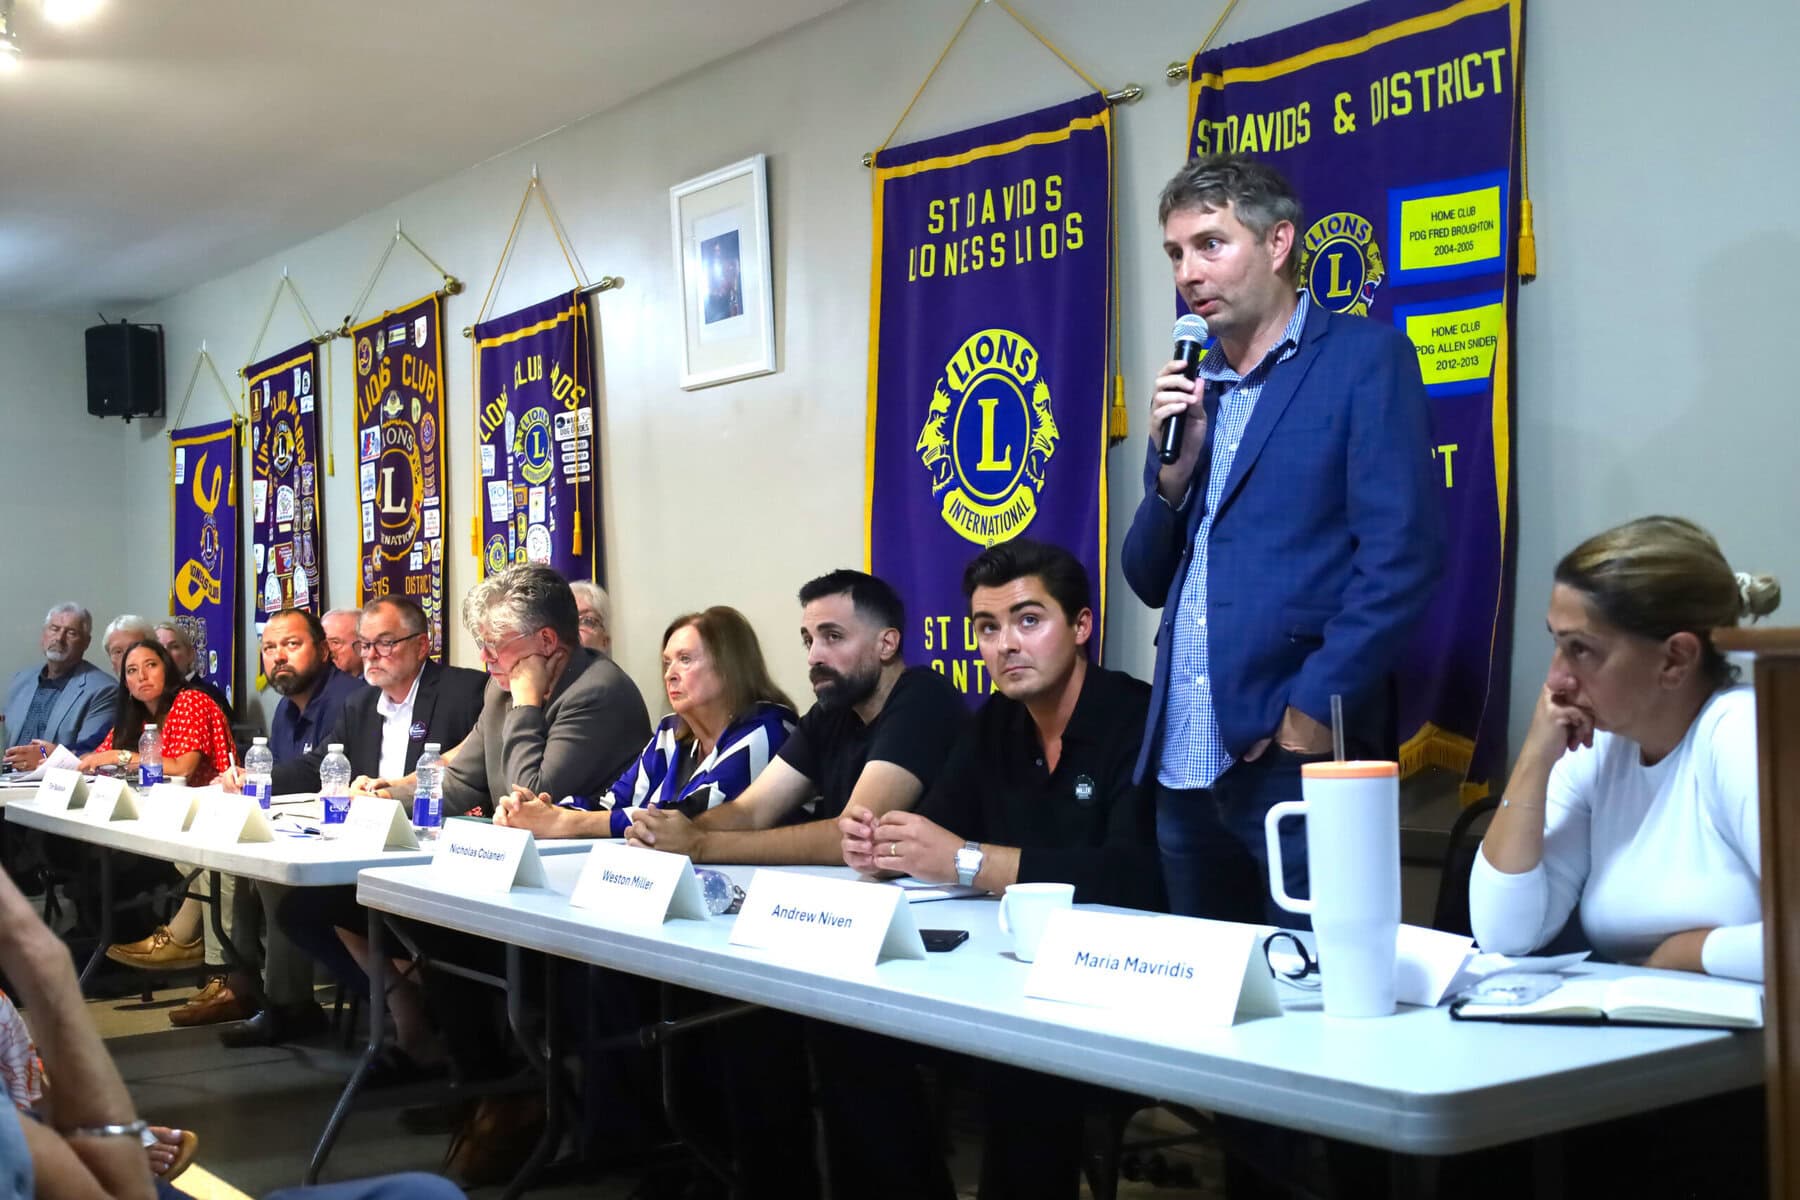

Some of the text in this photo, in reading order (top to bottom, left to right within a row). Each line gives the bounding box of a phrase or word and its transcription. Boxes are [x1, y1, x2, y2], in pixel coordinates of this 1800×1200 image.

[1333, 92, 1356, 134] &
[1370, 48, 1506, 127] DISTRICT
[1431, 206, 1476, 221] HOME CLUB
[1309, 216, 1369, 247] LIONS
[1409, 220, 1494, 241] PDG FRED BROUGHTON
[1327, 253, 1351, 298] L
[1431, 320, 1480, 337] HOME CLUB
[1415, 335, 1498, 355] PDG ALLEN SNIDER
[952, 335, 1033, 385] LIONS
[1436, 355, 1479, 371] 2012-2013
[402, 353, 435, 404] CLUB
[533, 431, 545, 458] L
[976, 399, 1012, 471] L
[381, 467, 407, 513] L
[949, 496, 1031, 536] INTERNATIONAL
[924, 616, 951, 650] ST
[602, 869, 654, 891] Weston Miller
[771, 904, 853, 928] Andrew Niven
[1074, 951, 1194, 979] Maria Mavridis
